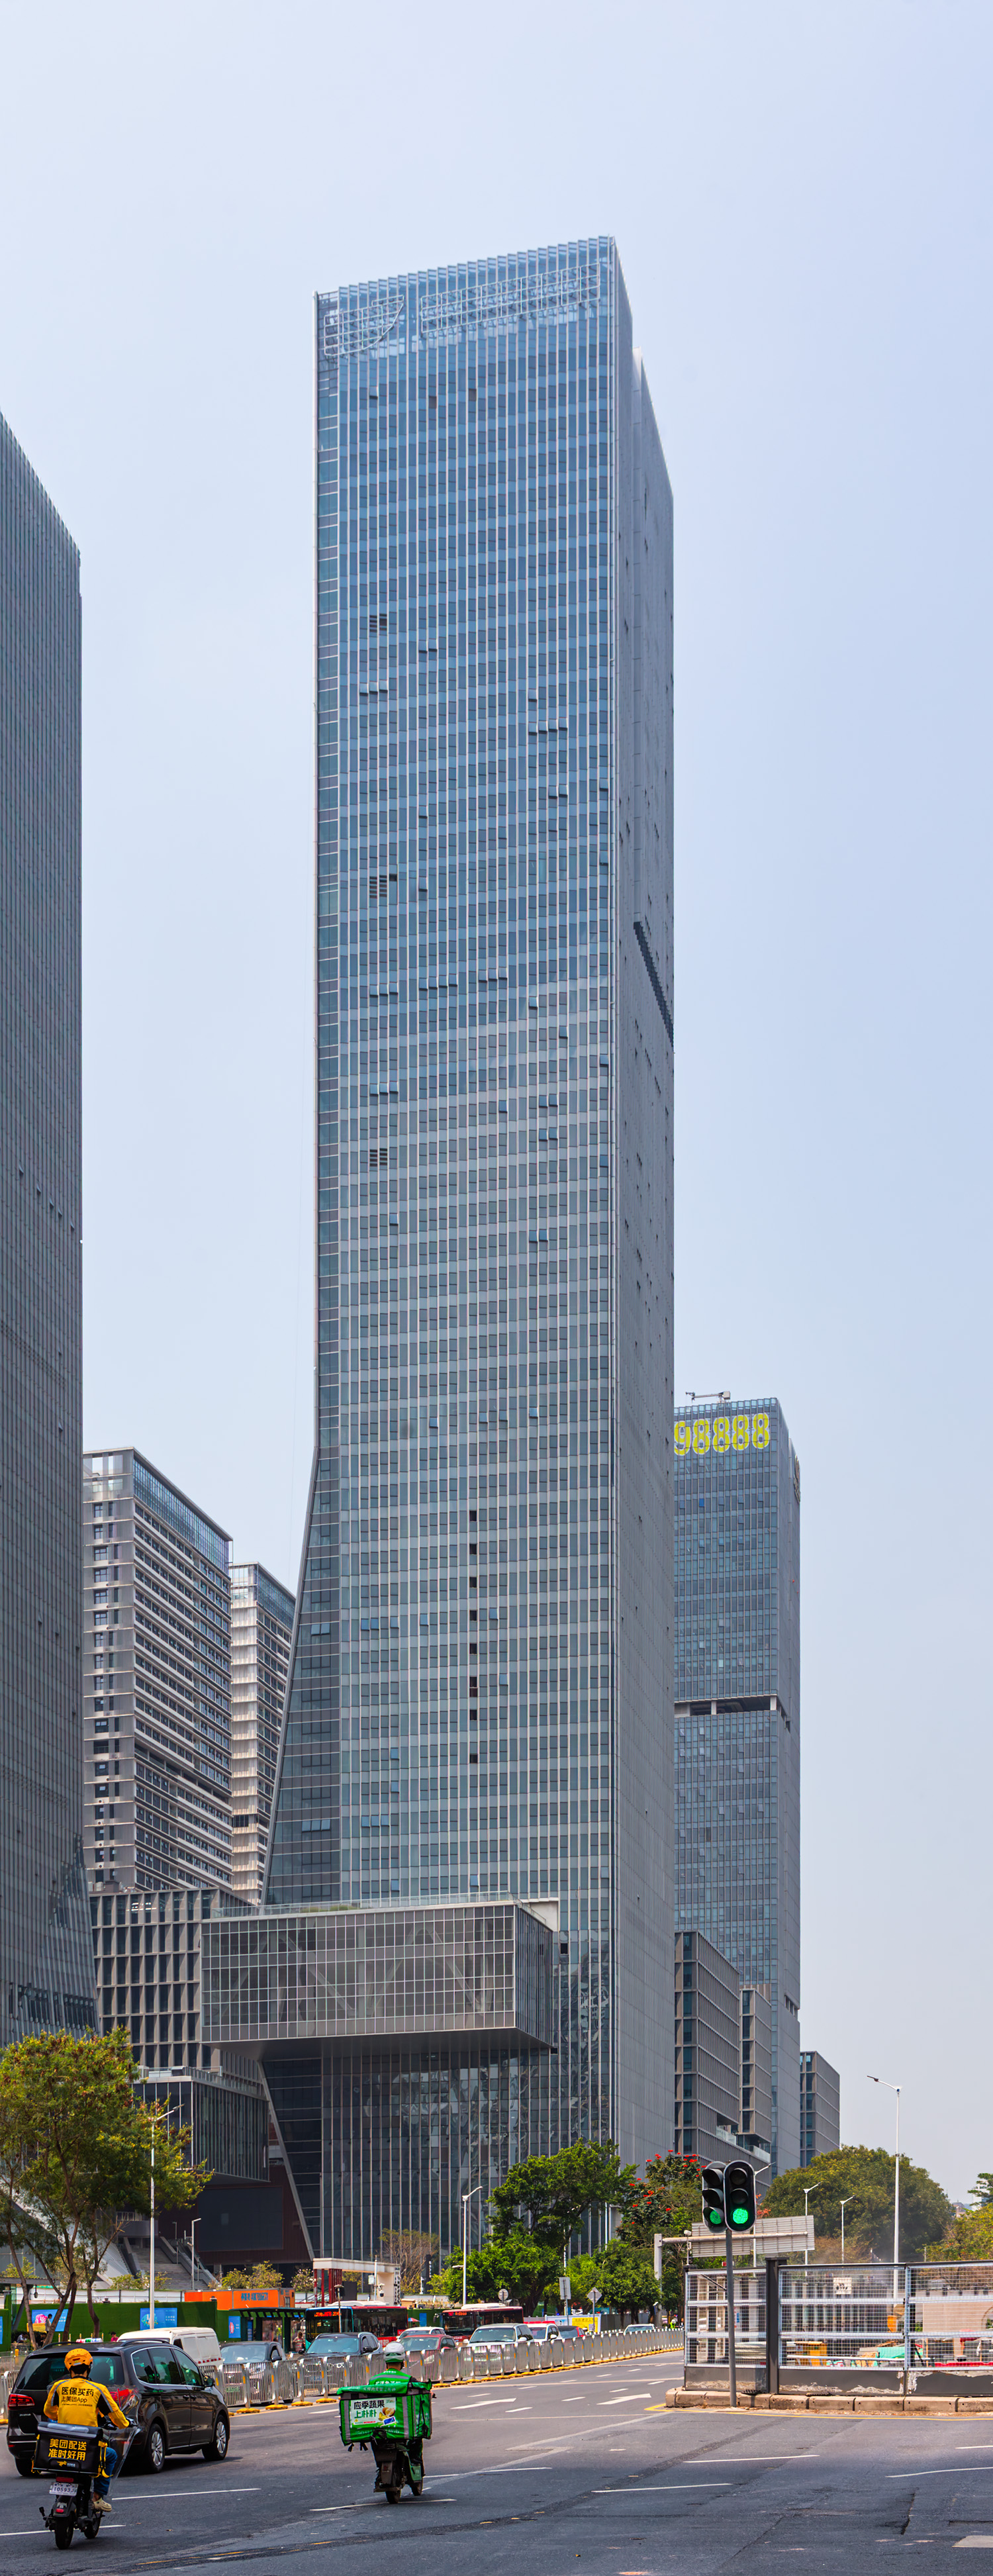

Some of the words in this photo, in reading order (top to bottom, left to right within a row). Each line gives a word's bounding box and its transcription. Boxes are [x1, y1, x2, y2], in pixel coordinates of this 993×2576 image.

[674, 1413, 770, 1456] 98888
[62, 2387, 94, 2397] 医保买药
[354, 2400, 385, 2410] 应季蔬果
[354, 2409, 377, 2418] 上朴朴
[50, 2438, 87, 2451] 美团配送
[48, 2448, 86, 2461] 准时好用
